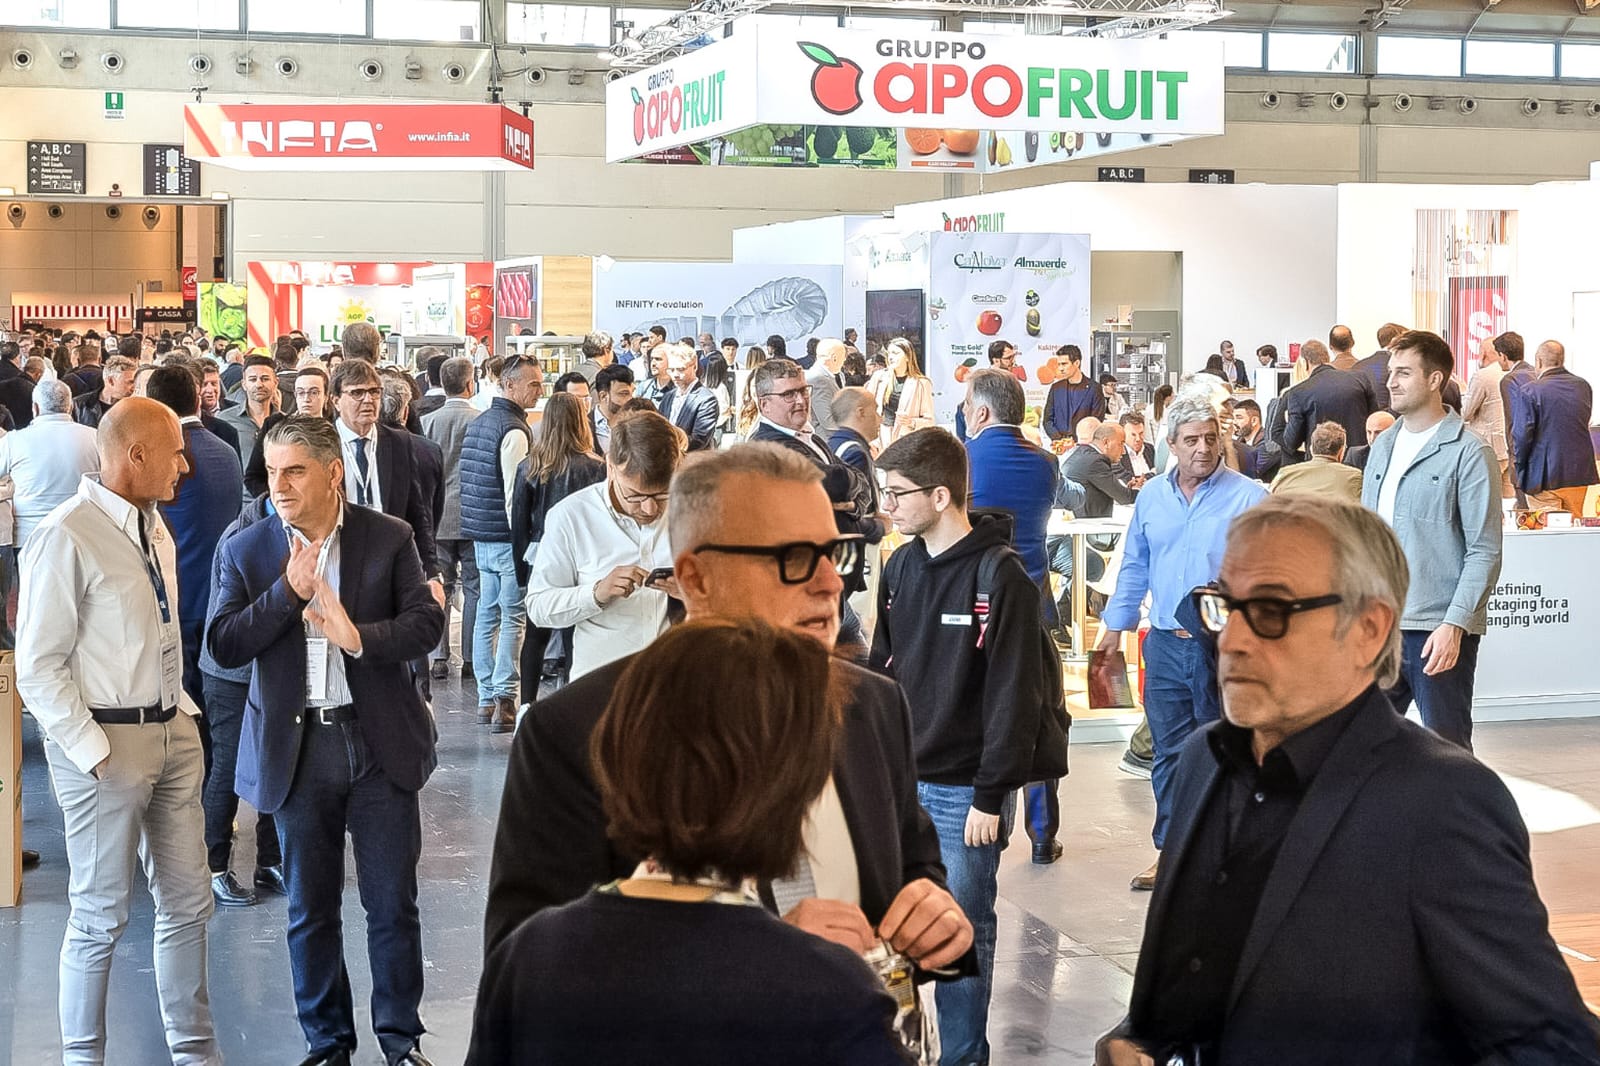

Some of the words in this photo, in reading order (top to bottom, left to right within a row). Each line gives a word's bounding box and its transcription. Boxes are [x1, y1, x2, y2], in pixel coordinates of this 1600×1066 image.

[876, 38, 986, 60] GRUPPO
[648, 68, 675, 91] GRUPPO
[408, 131, 471, 142] www.infia.it
[504, 124, 531, 163] INFIA
[1014, 256, 1068, 269] Almaverde
[615, 300, 654, 308] INFINITY
[656, 300, 704, 308] r-evolution
[1489, 583, 1541, 597] defining
[1487, 598, 1538, 612] ckaging
[1540, 597, 1558, 609] for
[1560, 599, 1569, 609] a
[1486, 613, 1530, 628] anging
[1533, 611, 1570, 624] world
